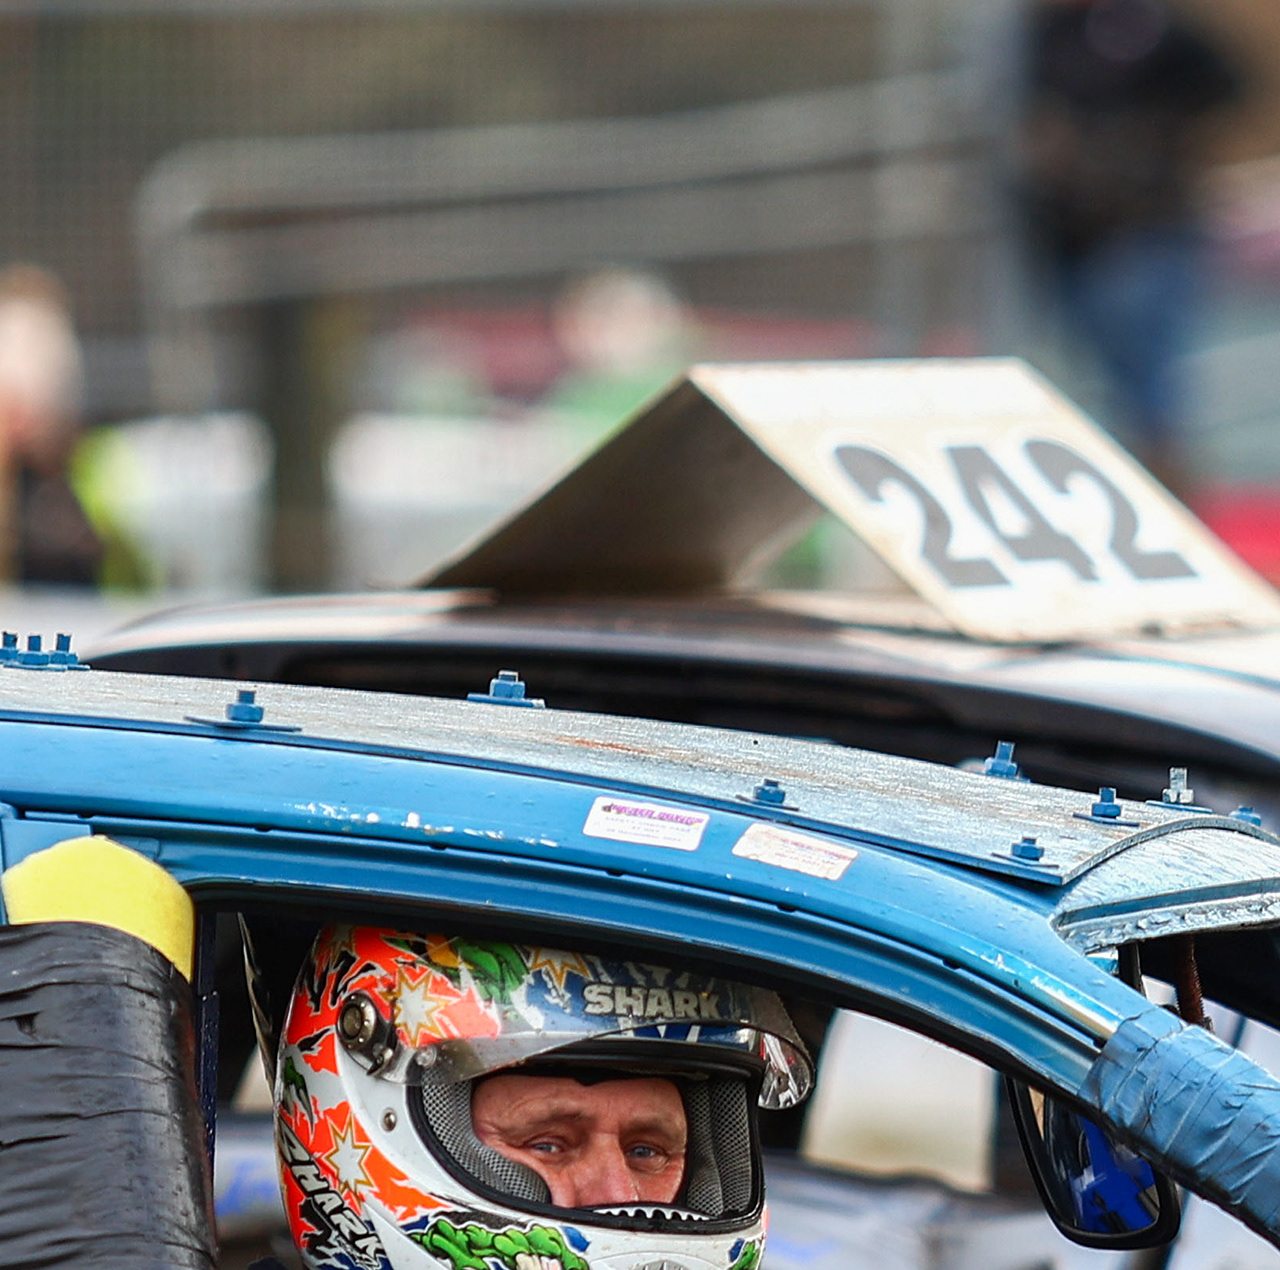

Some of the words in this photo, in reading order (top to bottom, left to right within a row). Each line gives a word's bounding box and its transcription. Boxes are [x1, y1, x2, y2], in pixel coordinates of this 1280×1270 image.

[833, 438, 1199, 589] 242
[582, 982, 723, 1020] SHARK
[278, 1115, 384, 1259] SHARK
